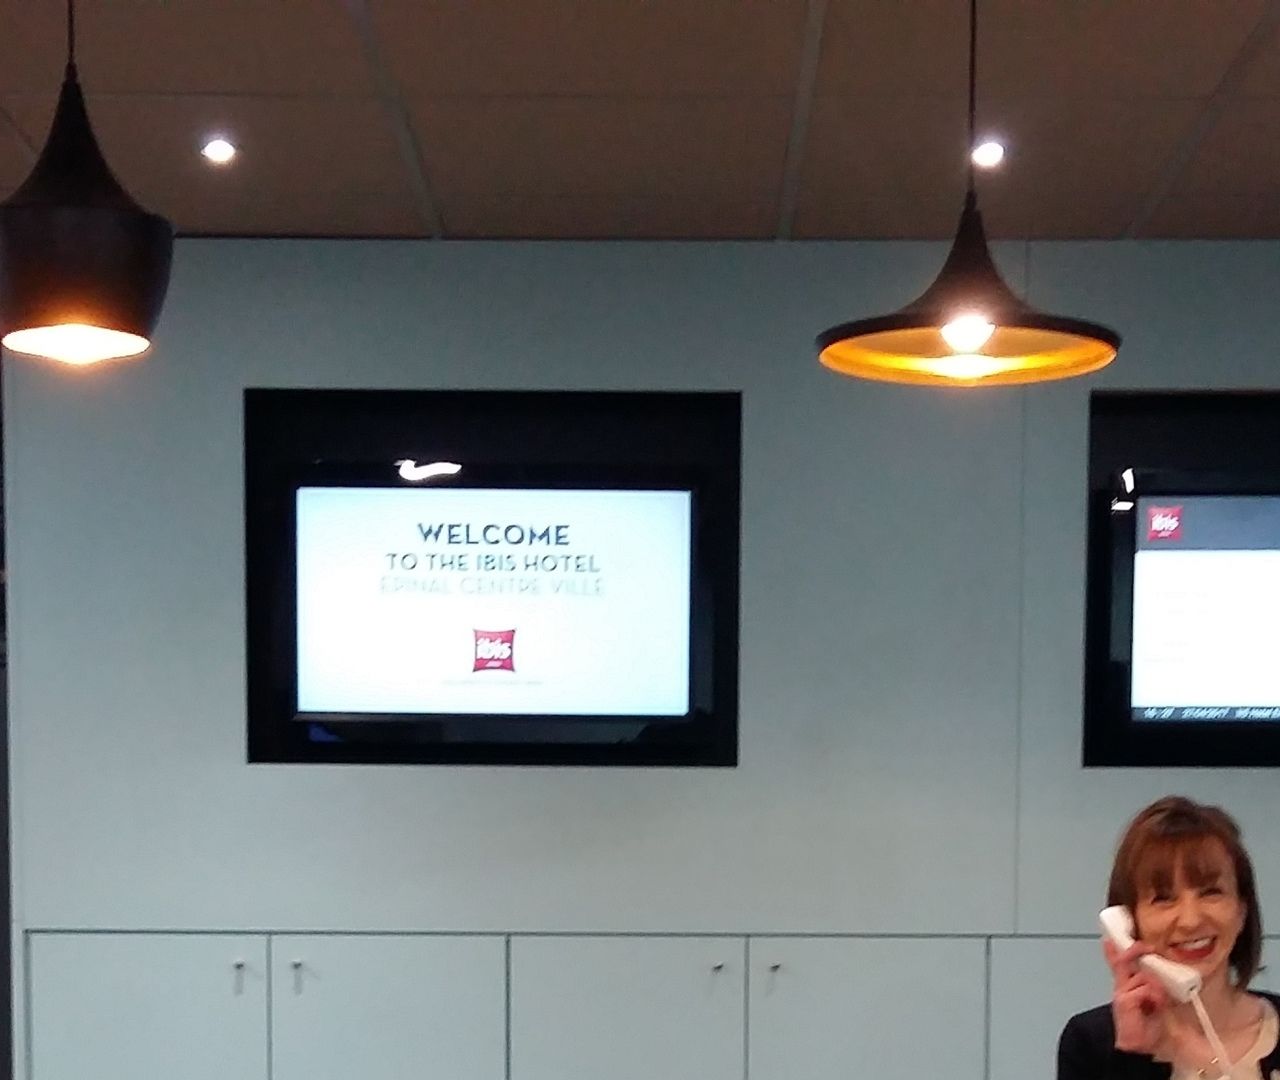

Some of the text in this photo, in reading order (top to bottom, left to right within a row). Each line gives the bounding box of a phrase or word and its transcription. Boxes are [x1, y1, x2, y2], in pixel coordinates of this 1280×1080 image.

[417, 523, 571, 546] WELCOME
[385, 553, 601, 572] TO THE IBIS HOTEL
[550, 576, 605, 596] VILLE
